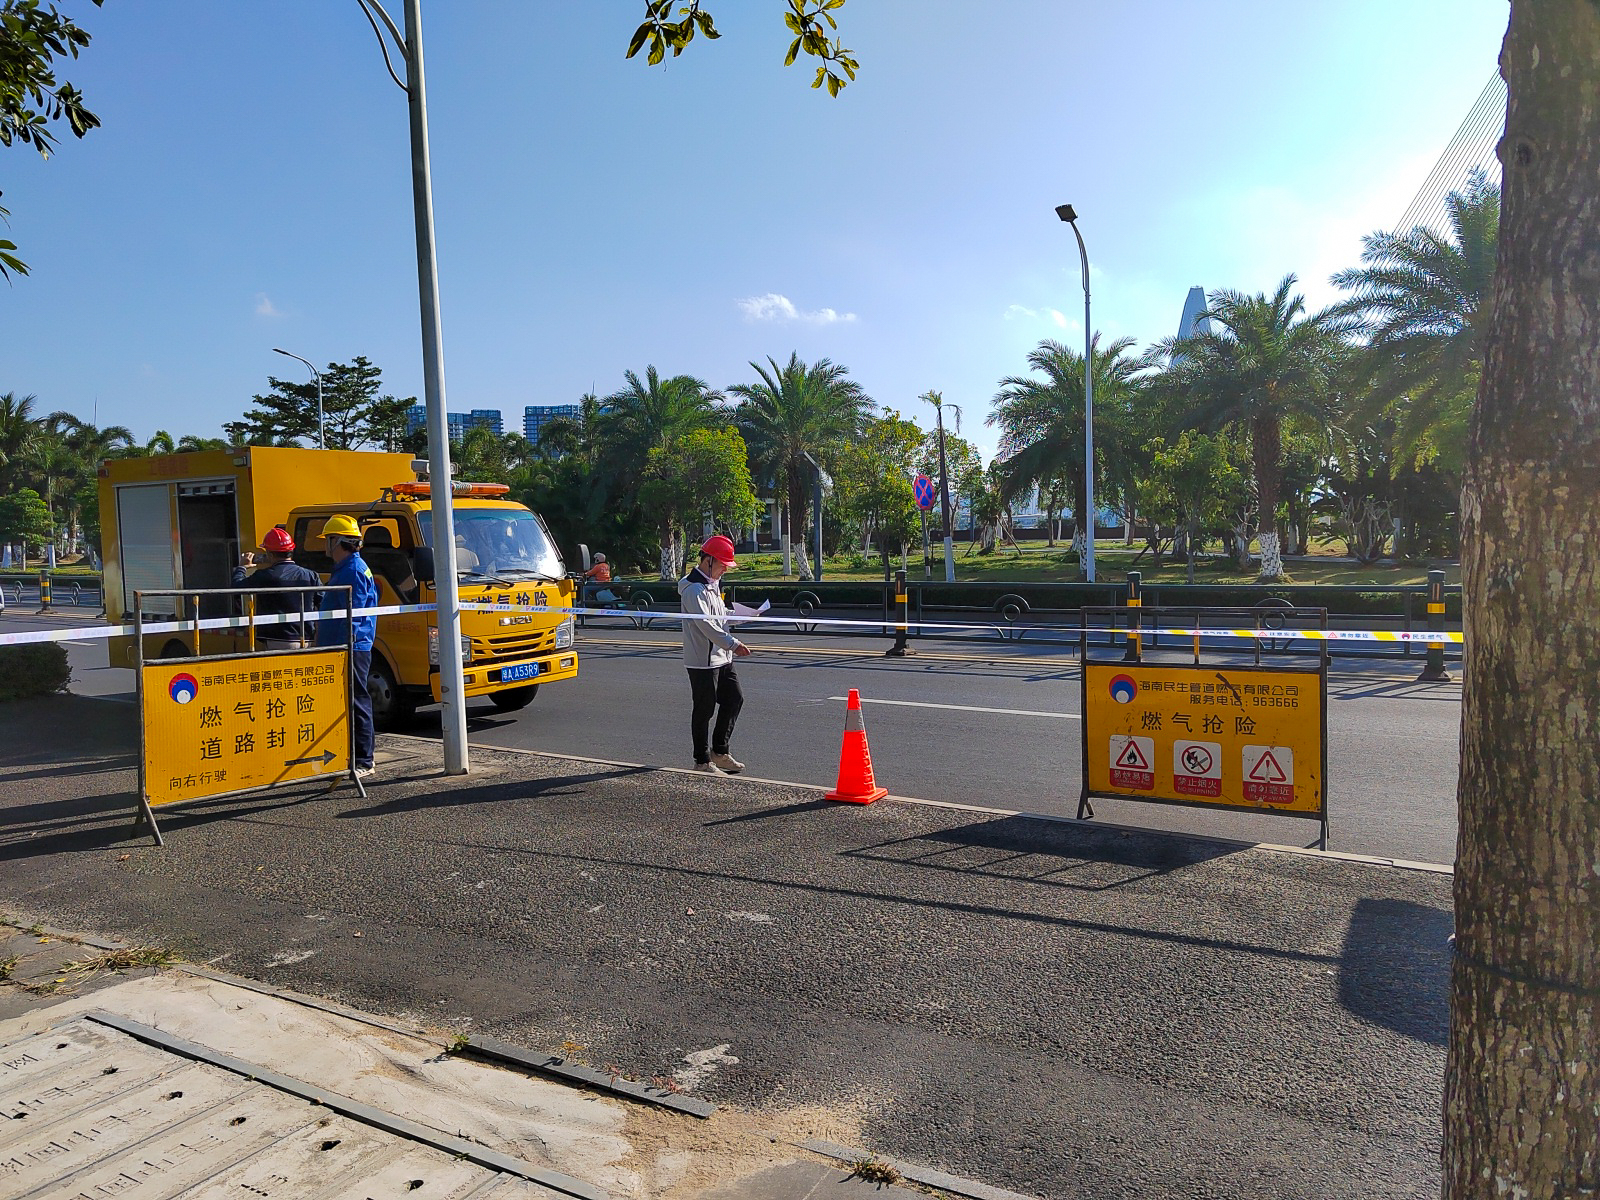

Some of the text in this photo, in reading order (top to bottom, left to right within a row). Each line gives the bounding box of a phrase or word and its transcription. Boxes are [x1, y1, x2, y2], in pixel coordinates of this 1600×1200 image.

[202, 665, 335, 687] 海南民生管道燃气有限公司
[1139, 680, 1299, 697] 海南民生管道燃气有限公司
[199, 694, 315, 728] 燃气抢险
[1141, 711, 1257, 736] 燃气抢险
[200, 723, 315, 761] 道路封闭
[169, 769, 227, 790] 向右行驶
[1177, 776, 1217, 789] 禁止烟火
